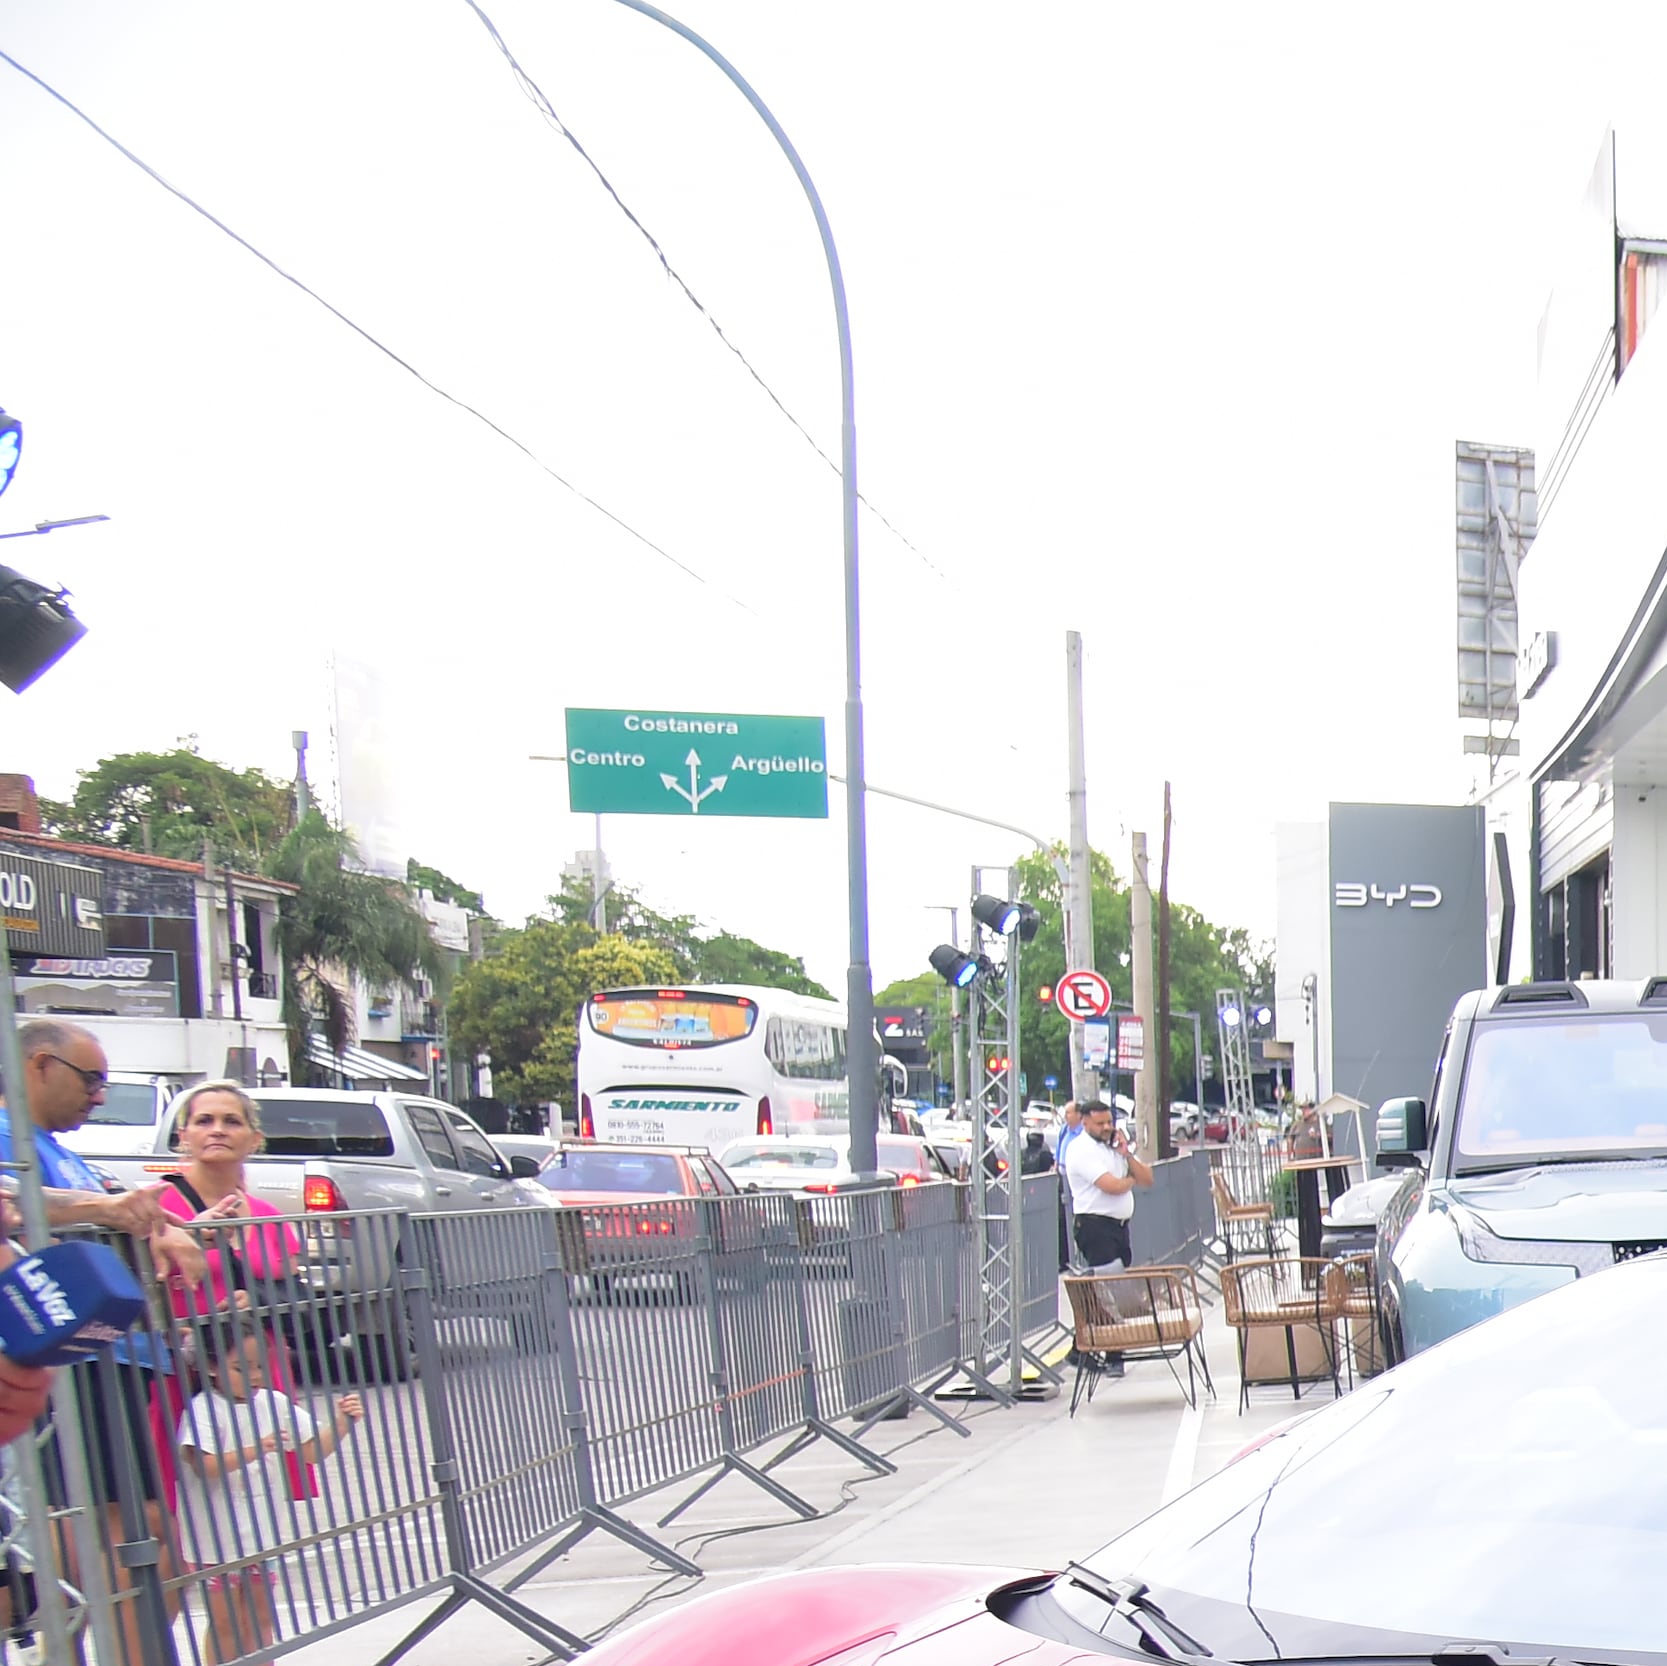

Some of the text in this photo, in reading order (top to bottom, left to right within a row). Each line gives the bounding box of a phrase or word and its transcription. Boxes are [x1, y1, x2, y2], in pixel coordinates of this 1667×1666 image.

[623, 714, 739, 735] Costanera
[569, 748, 646, 768] Centro
[731, 754, 825, 776] Argüello
[1335, 883, 1443, 908] BYD
[1072, 982, 1094, 1010] E
[607, 1099, 742, 1113] SARMIENTO
